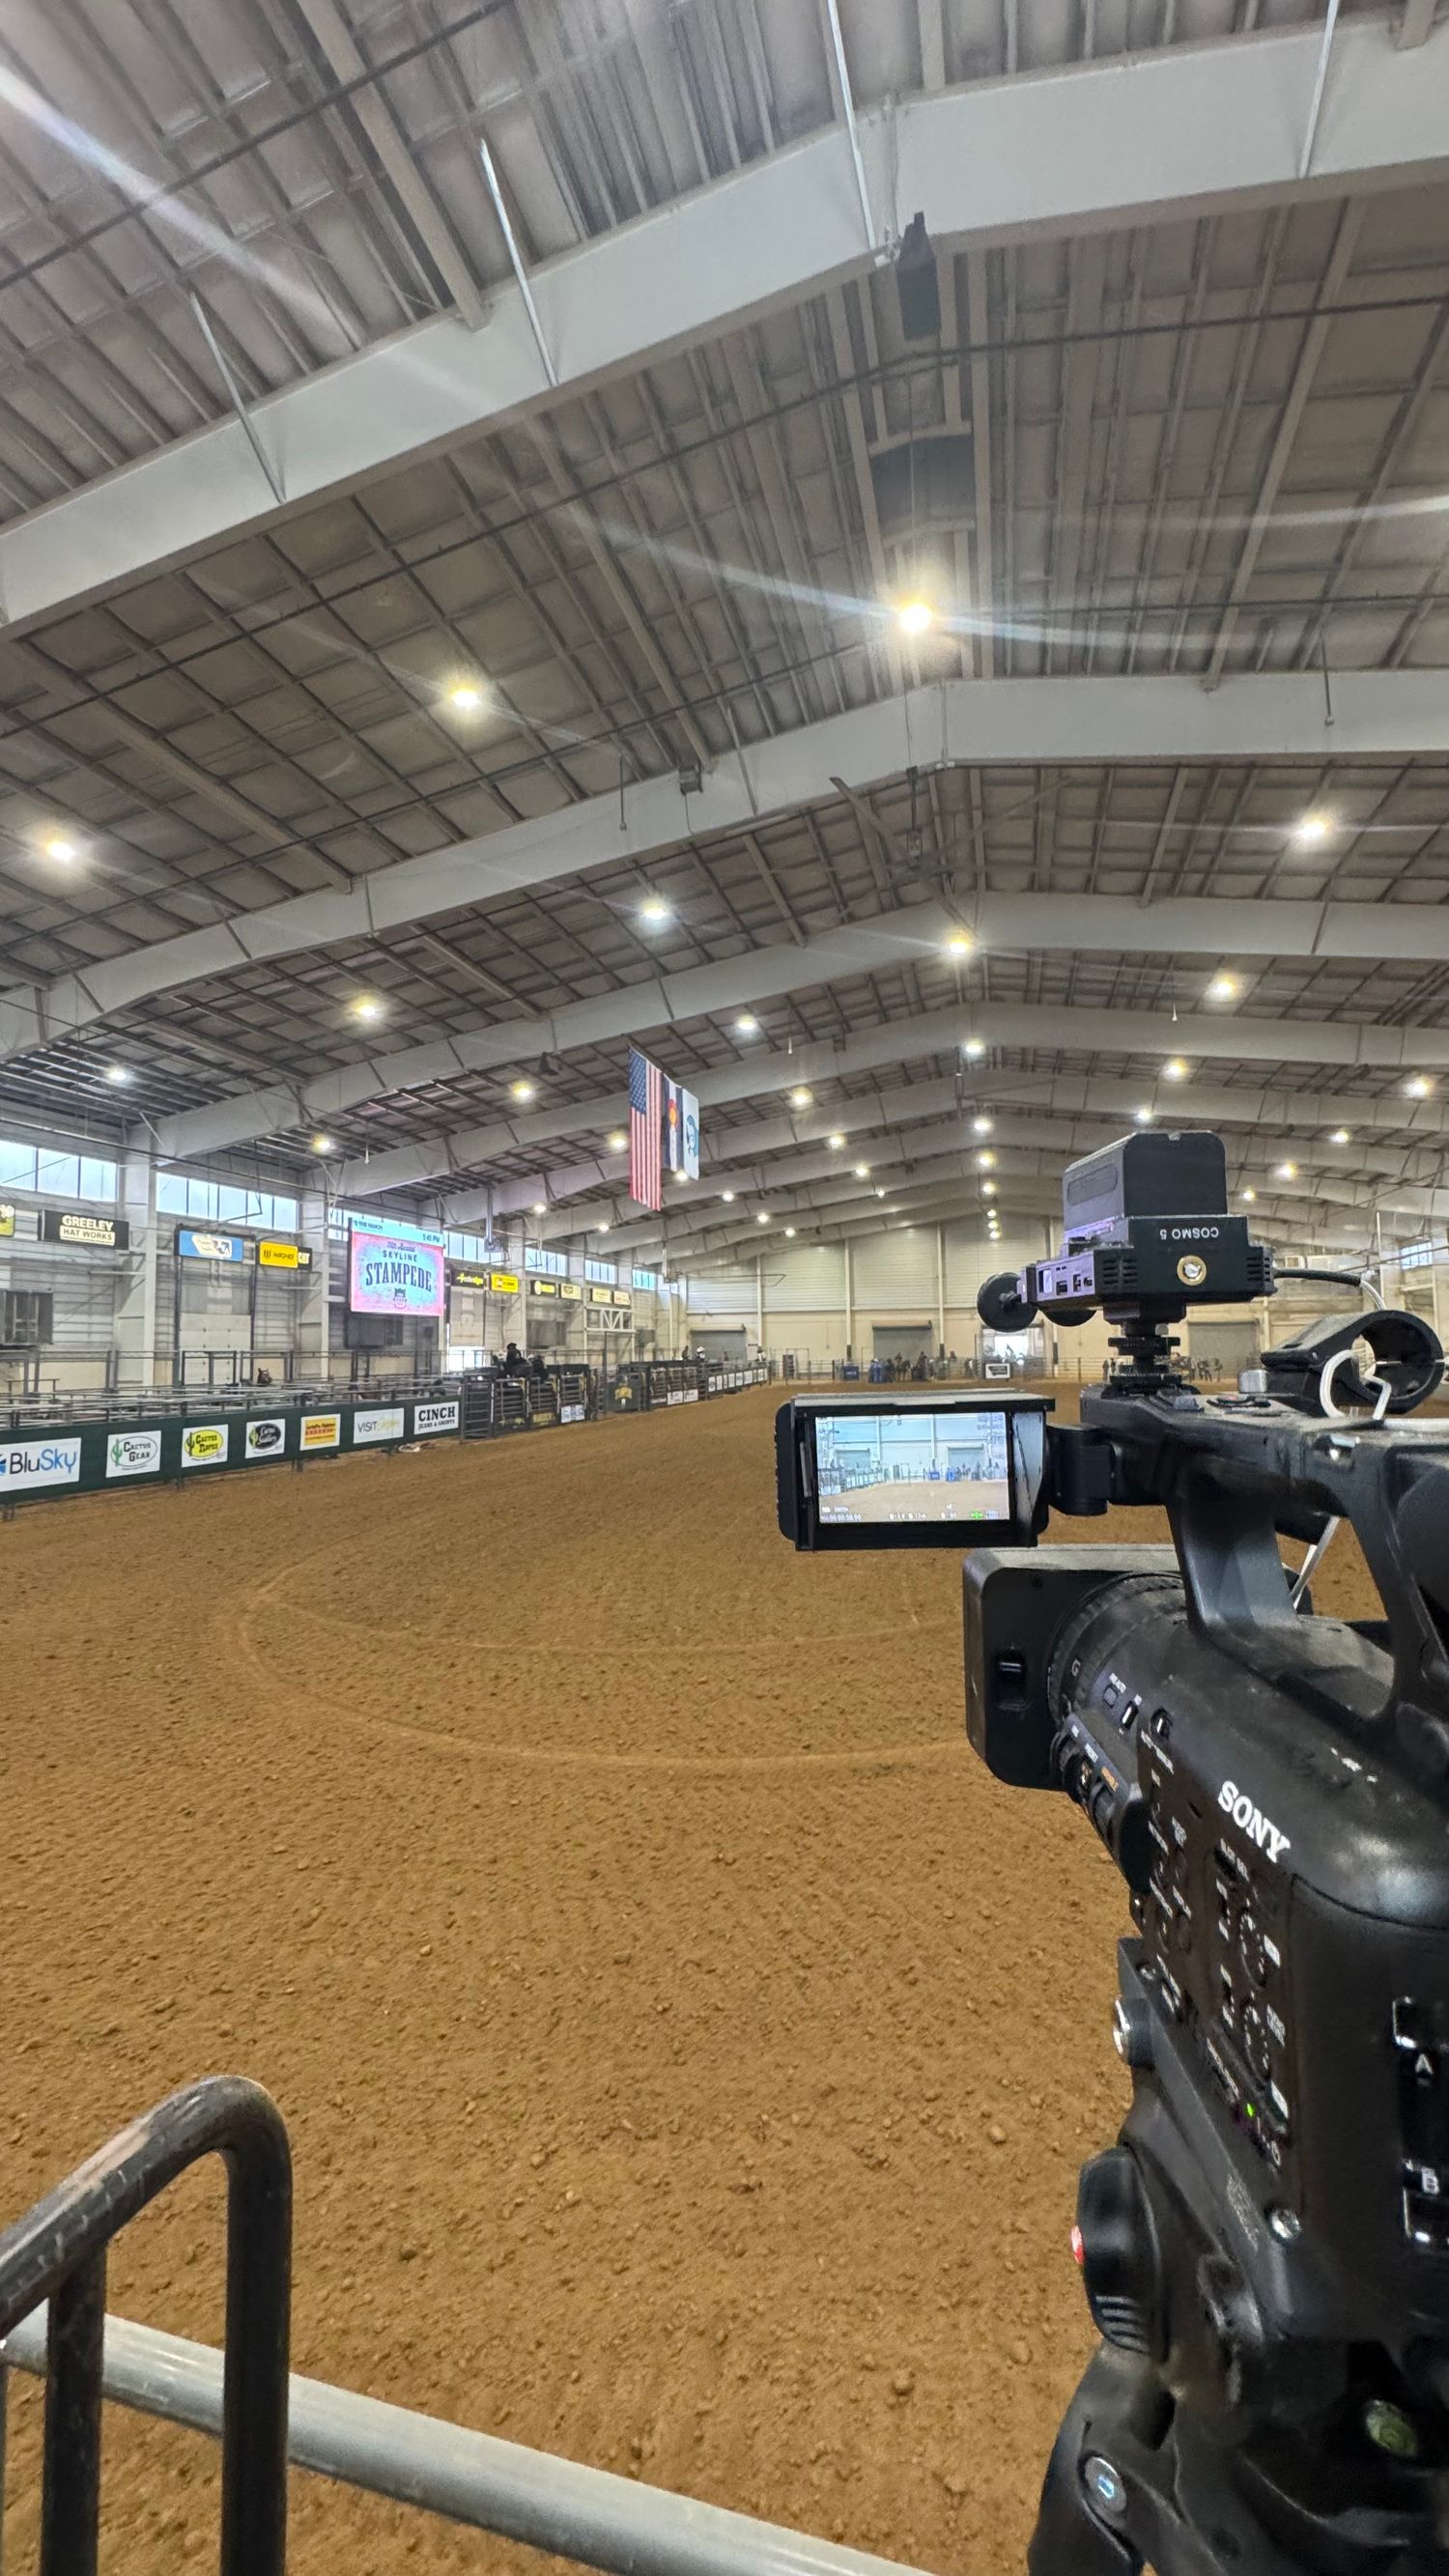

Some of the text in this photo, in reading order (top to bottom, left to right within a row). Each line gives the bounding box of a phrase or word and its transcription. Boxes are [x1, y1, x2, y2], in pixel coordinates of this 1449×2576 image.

[62, 1215, 114, 1231] GREELEY
[83, 1231, 112, 1240] WORKS
[1172, 1228, 1219, 1239] COSMO
[383, 1250, 417, 1261] SKYLINE
[366, 1262, 432, 1292] STAMPEDE
[418, 1406, 455, 1422] CINCH
[357, 1421, 378, 1432] VISIT
[124, 1441, 151, 1452] CACTUS
[10, 1448, 77, 1474] BluSky
[128, 1451, 151, 1461] GEAR
[1217, 1780, 1291, 1863] SONY
